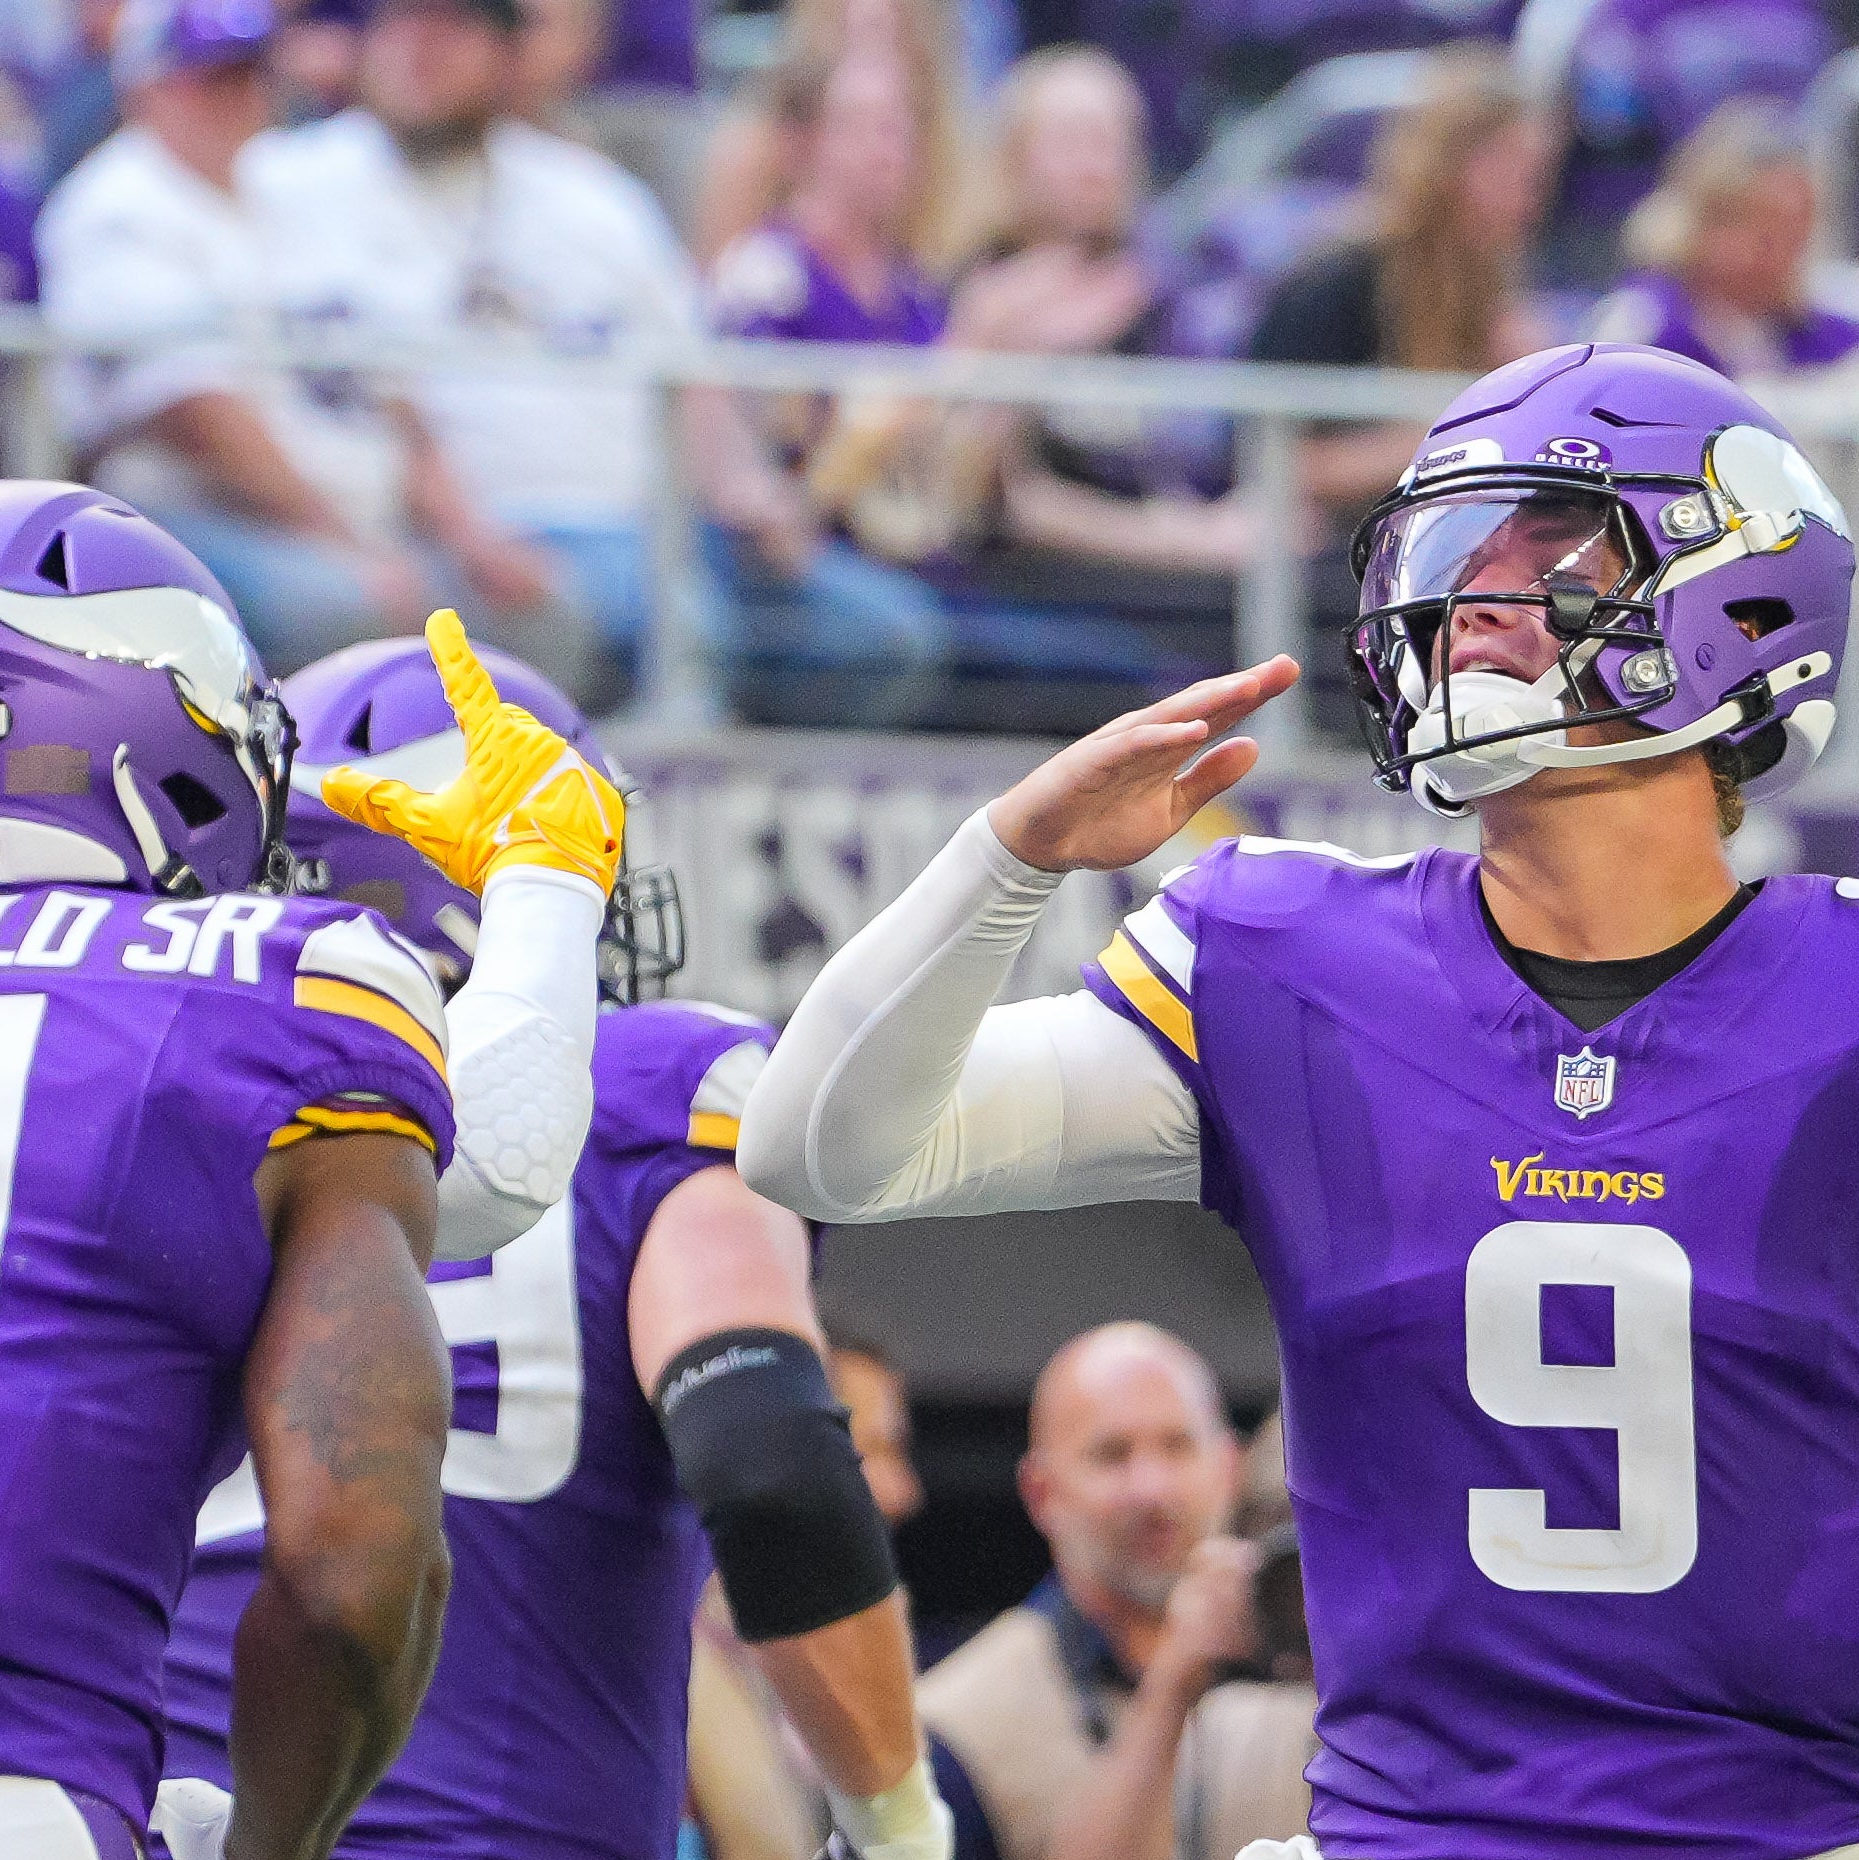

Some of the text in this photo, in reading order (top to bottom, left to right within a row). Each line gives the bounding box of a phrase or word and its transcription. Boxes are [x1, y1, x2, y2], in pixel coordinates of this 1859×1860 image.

[1535, 453, 1611, 470] OAKLEY
[121, 895, 284, 986] SR
[1465, 1220, 1697, 1594] 9
